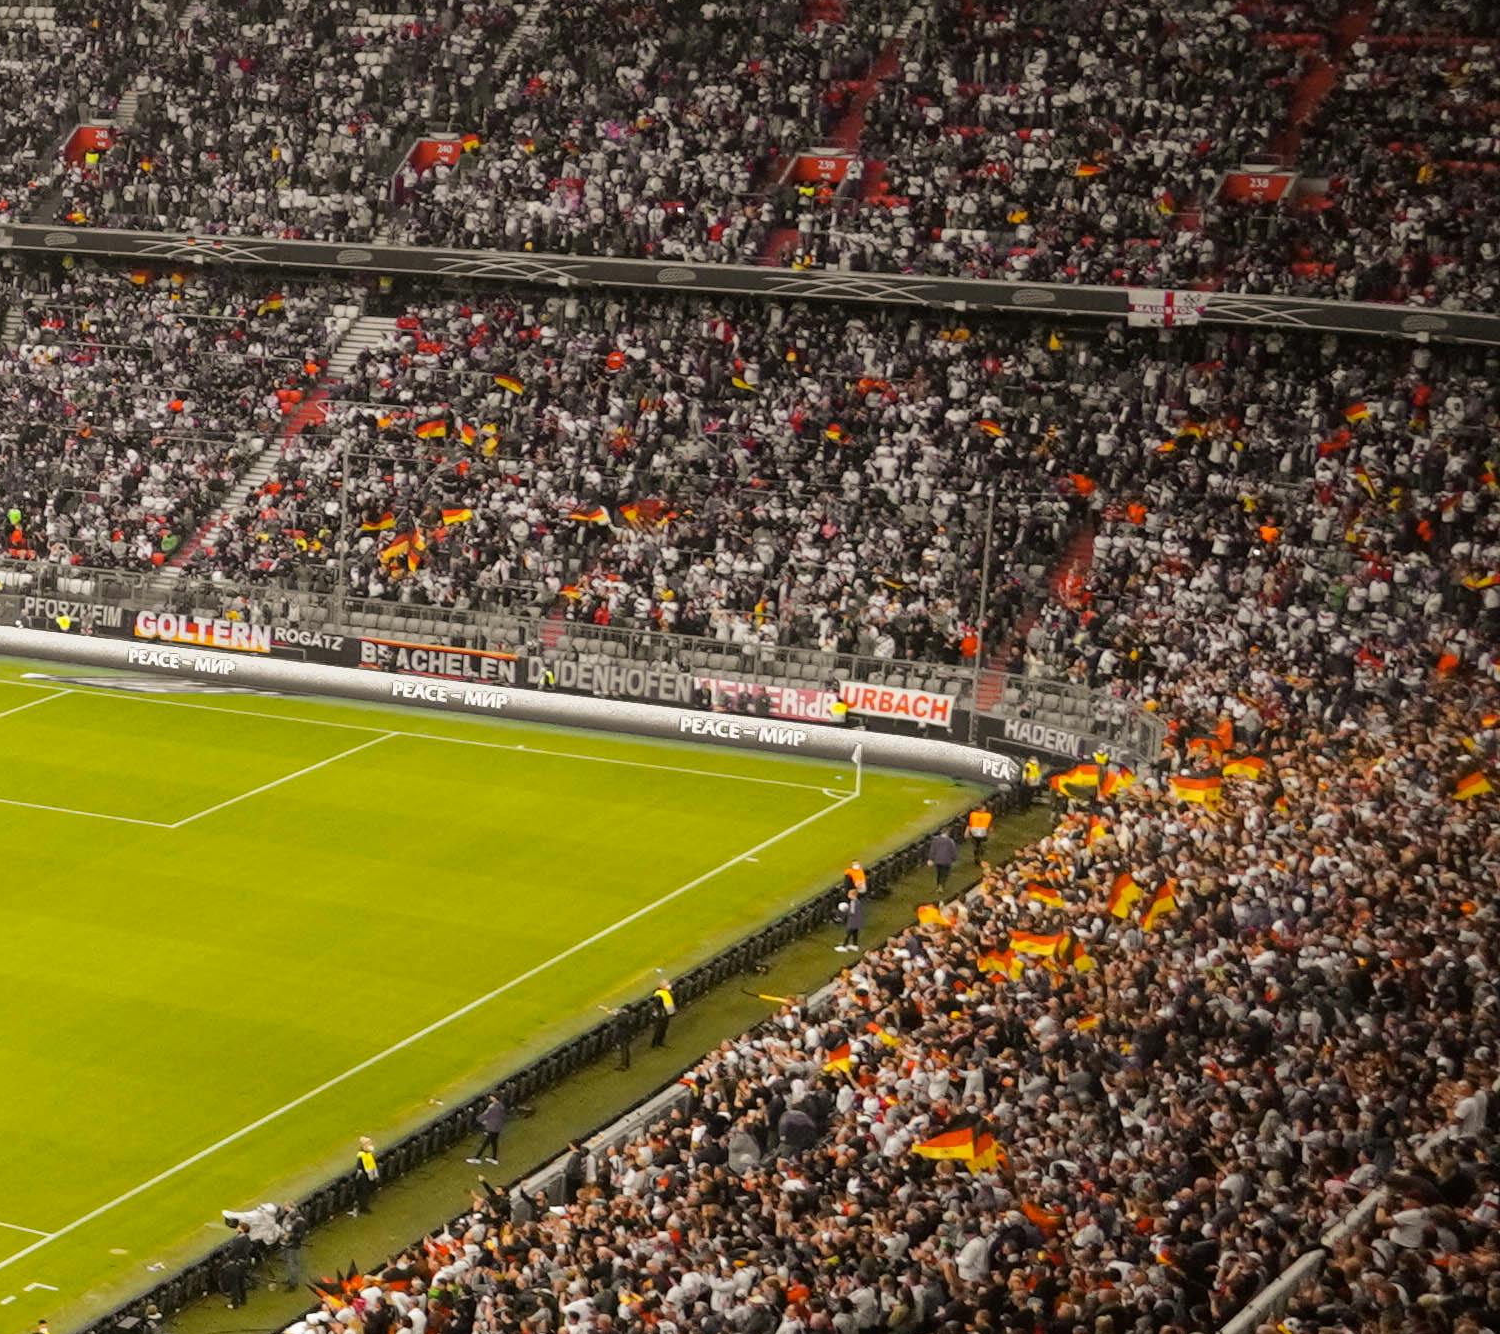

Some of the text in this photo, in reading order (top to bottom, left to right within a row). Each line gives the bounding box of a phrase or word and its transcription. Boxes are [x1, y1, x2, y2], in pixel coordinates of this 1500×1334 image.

[135, 610, 272, 653] GOLTERN
[127, 647, 182, 670] PEACE
[392, 680, 448, 704] PEACE
[842, 682, 951, 724] URBACH
[679, 715, 740, 741] PEACE
[1004, 718, 1081, 756] HADERN
